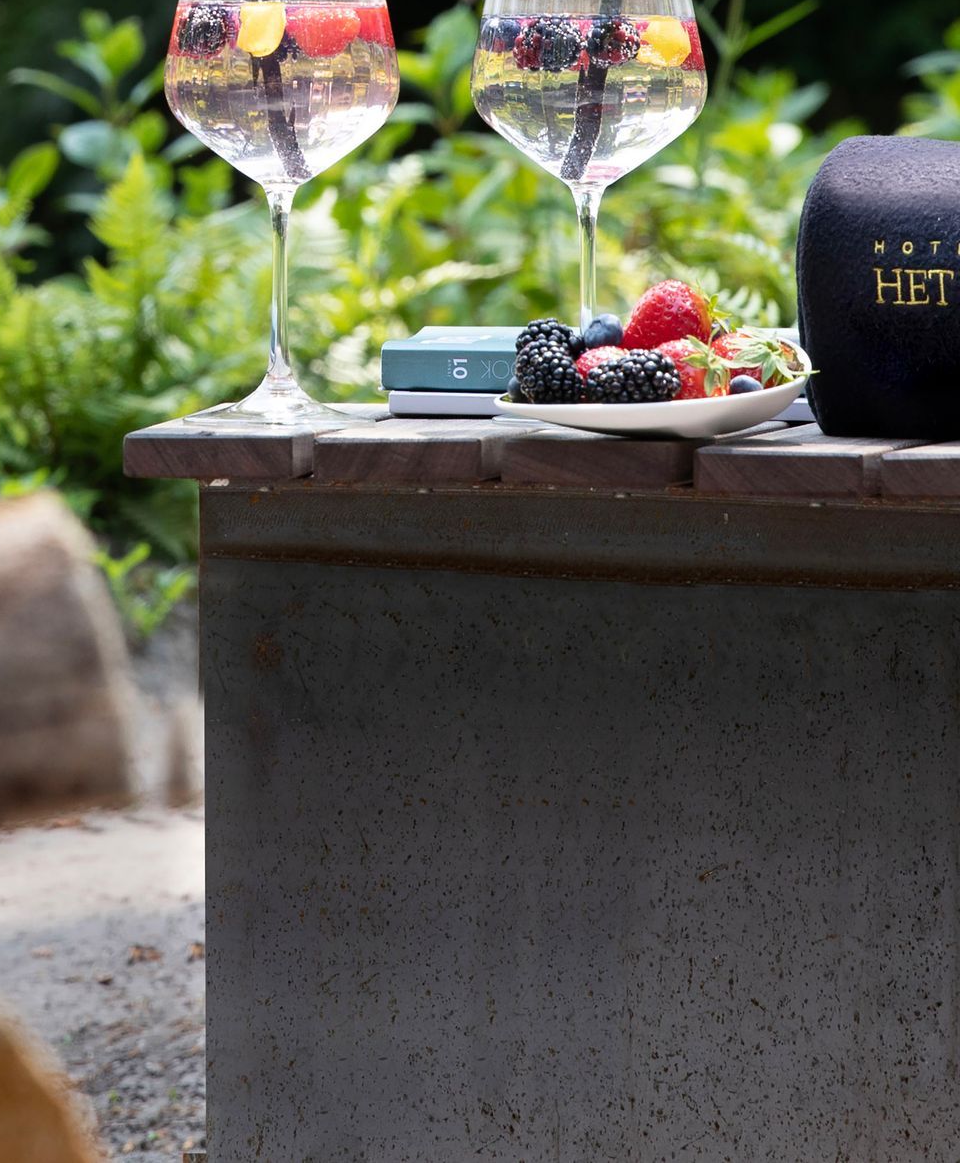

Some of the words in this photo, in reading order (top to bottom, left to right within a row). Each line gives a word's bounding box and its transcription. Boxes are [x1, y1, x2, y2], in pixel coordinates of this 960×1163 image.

[874, 240, 960, 254] HOT
[873, 268, 954, 306] HET
[481, 360, 517, 379] OK
